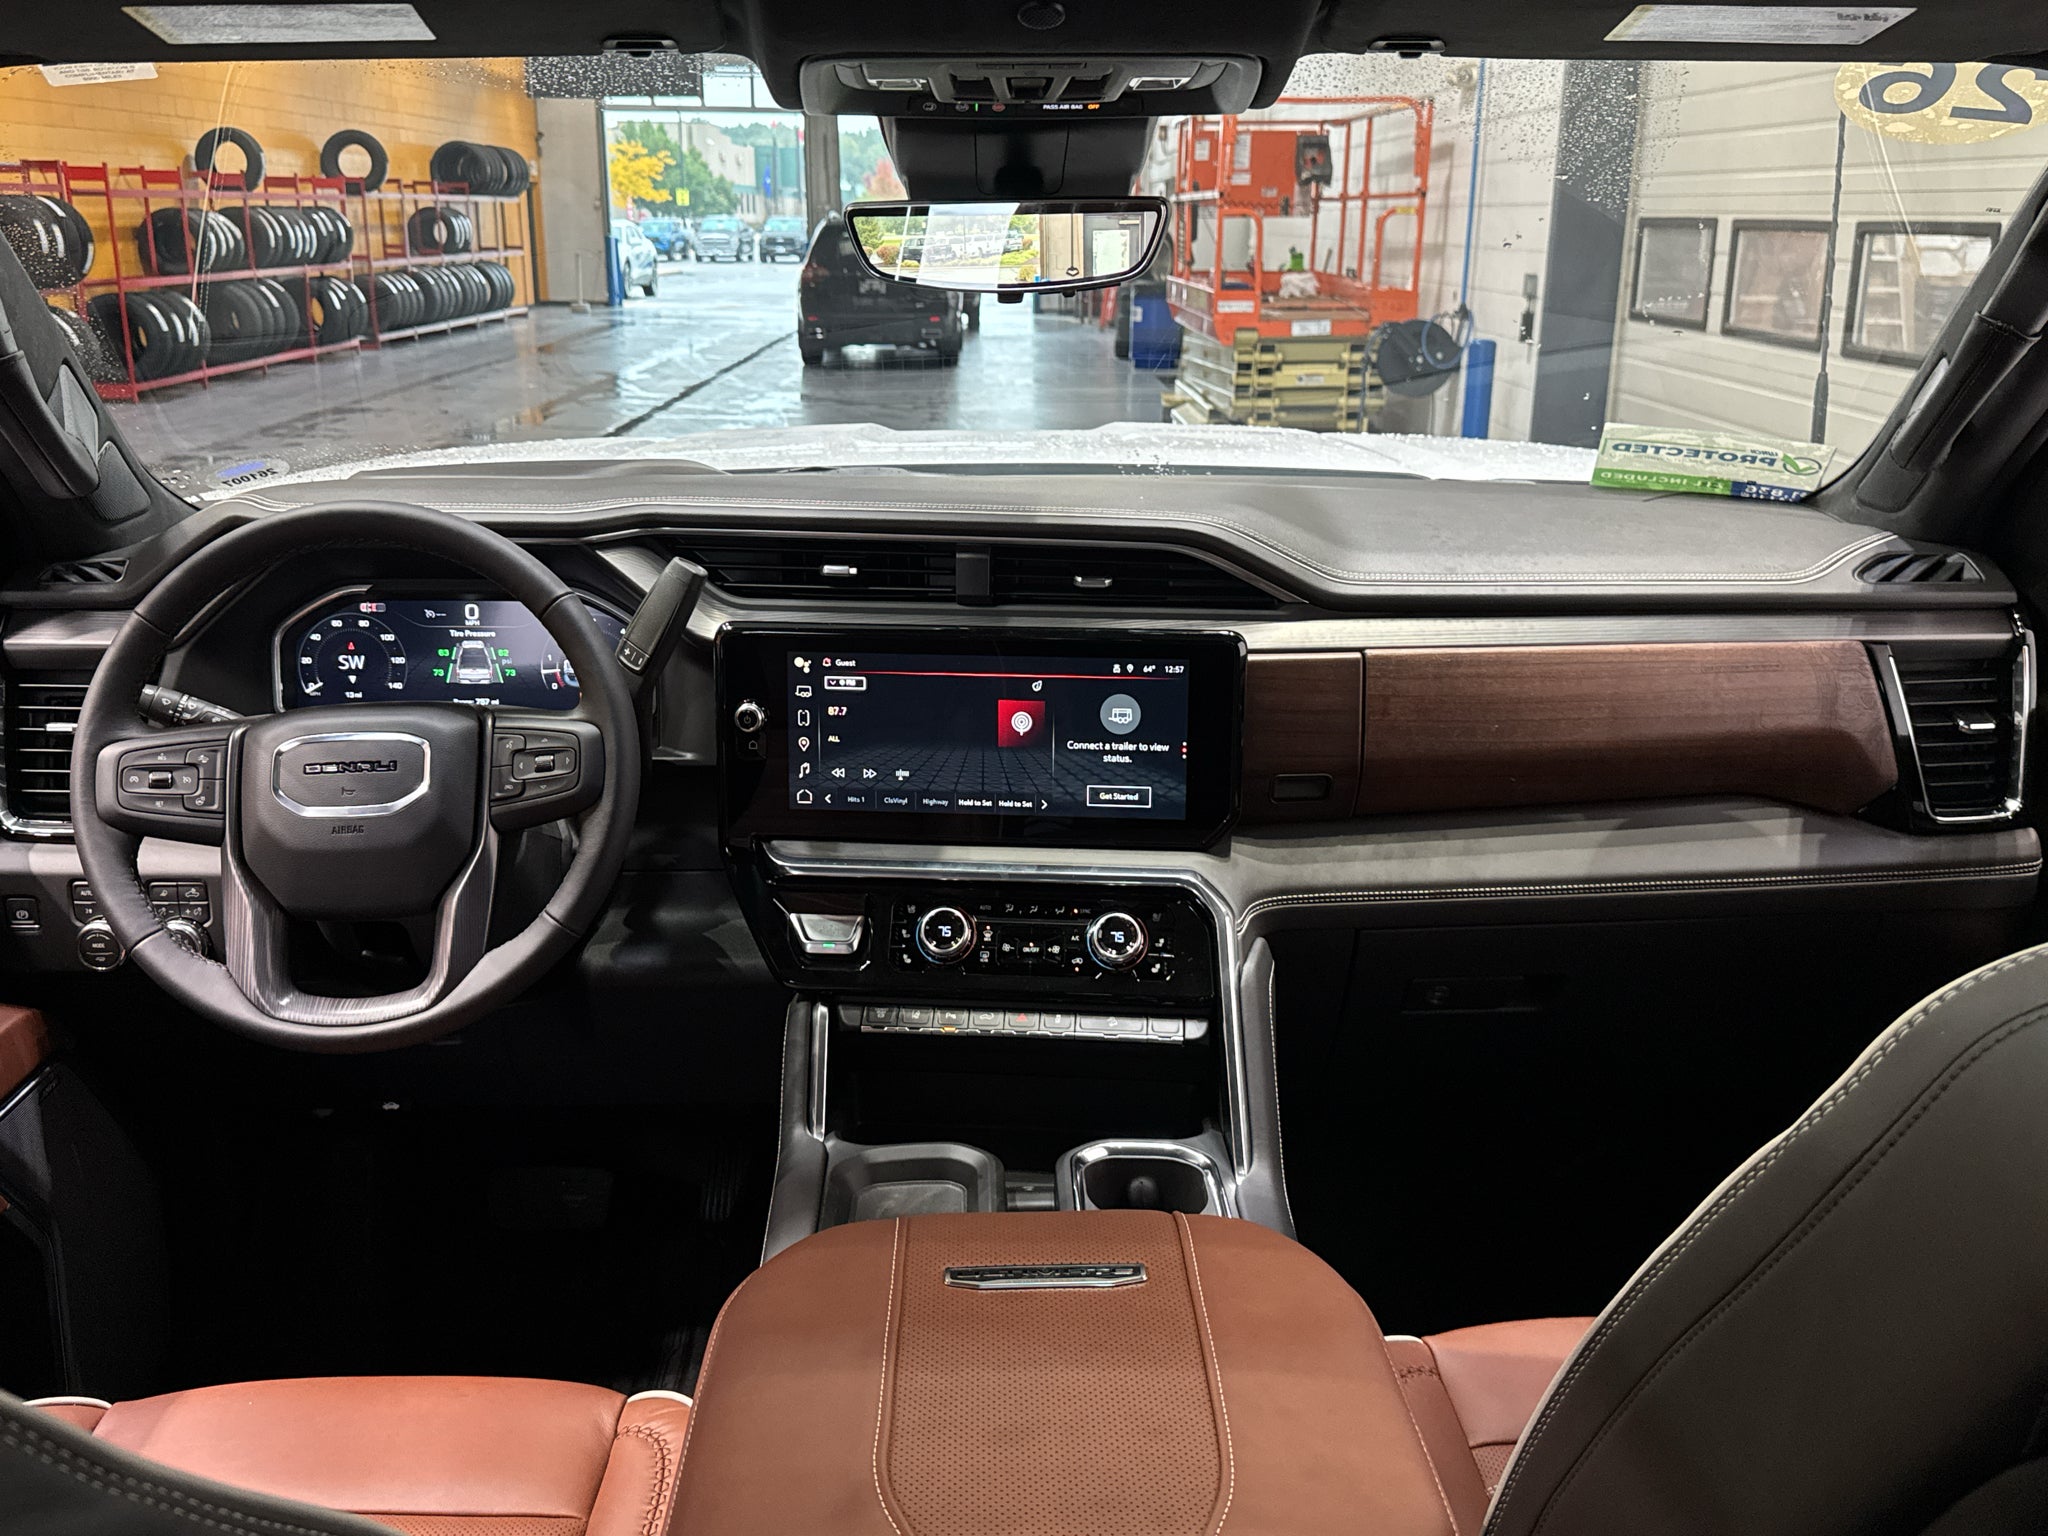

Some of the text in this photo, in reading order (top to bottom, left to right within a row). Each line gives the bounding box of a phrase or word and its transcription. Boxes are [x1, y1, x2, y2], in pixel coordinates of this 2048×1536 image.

[464, 604, 479, 620] 0
[380, 633, 394, 641] 100
[449, 629, 496, 638] Tire Pressure
[338, 655, 365, 669] SW
[501, 658, 512, 666] psi
[835, 659, 856, 667] Guest
[1164, 666, 1184, 674] 12:57
[1067, 740, 1103, 750] Connect
[1112, 741, 1137, 751] trailer
[1138, 743, 1148, 751] to
[1150, 743, 1170, 752] view
[1103, 754, 1132, 763] status.
[303, 760, 398, 775] DENALI
[1100, 792, 1138, 801] Get Started
[922, 798, 949, 807] Highway
[958, 799, 993, 807] Hold to Set
[998, 800, 1033, 808] Hold to Set
[331, 825, 364, 836] AIRBAG
[938, 926, 951, 937] 75
[1110, 931, 1124, 943] 75
